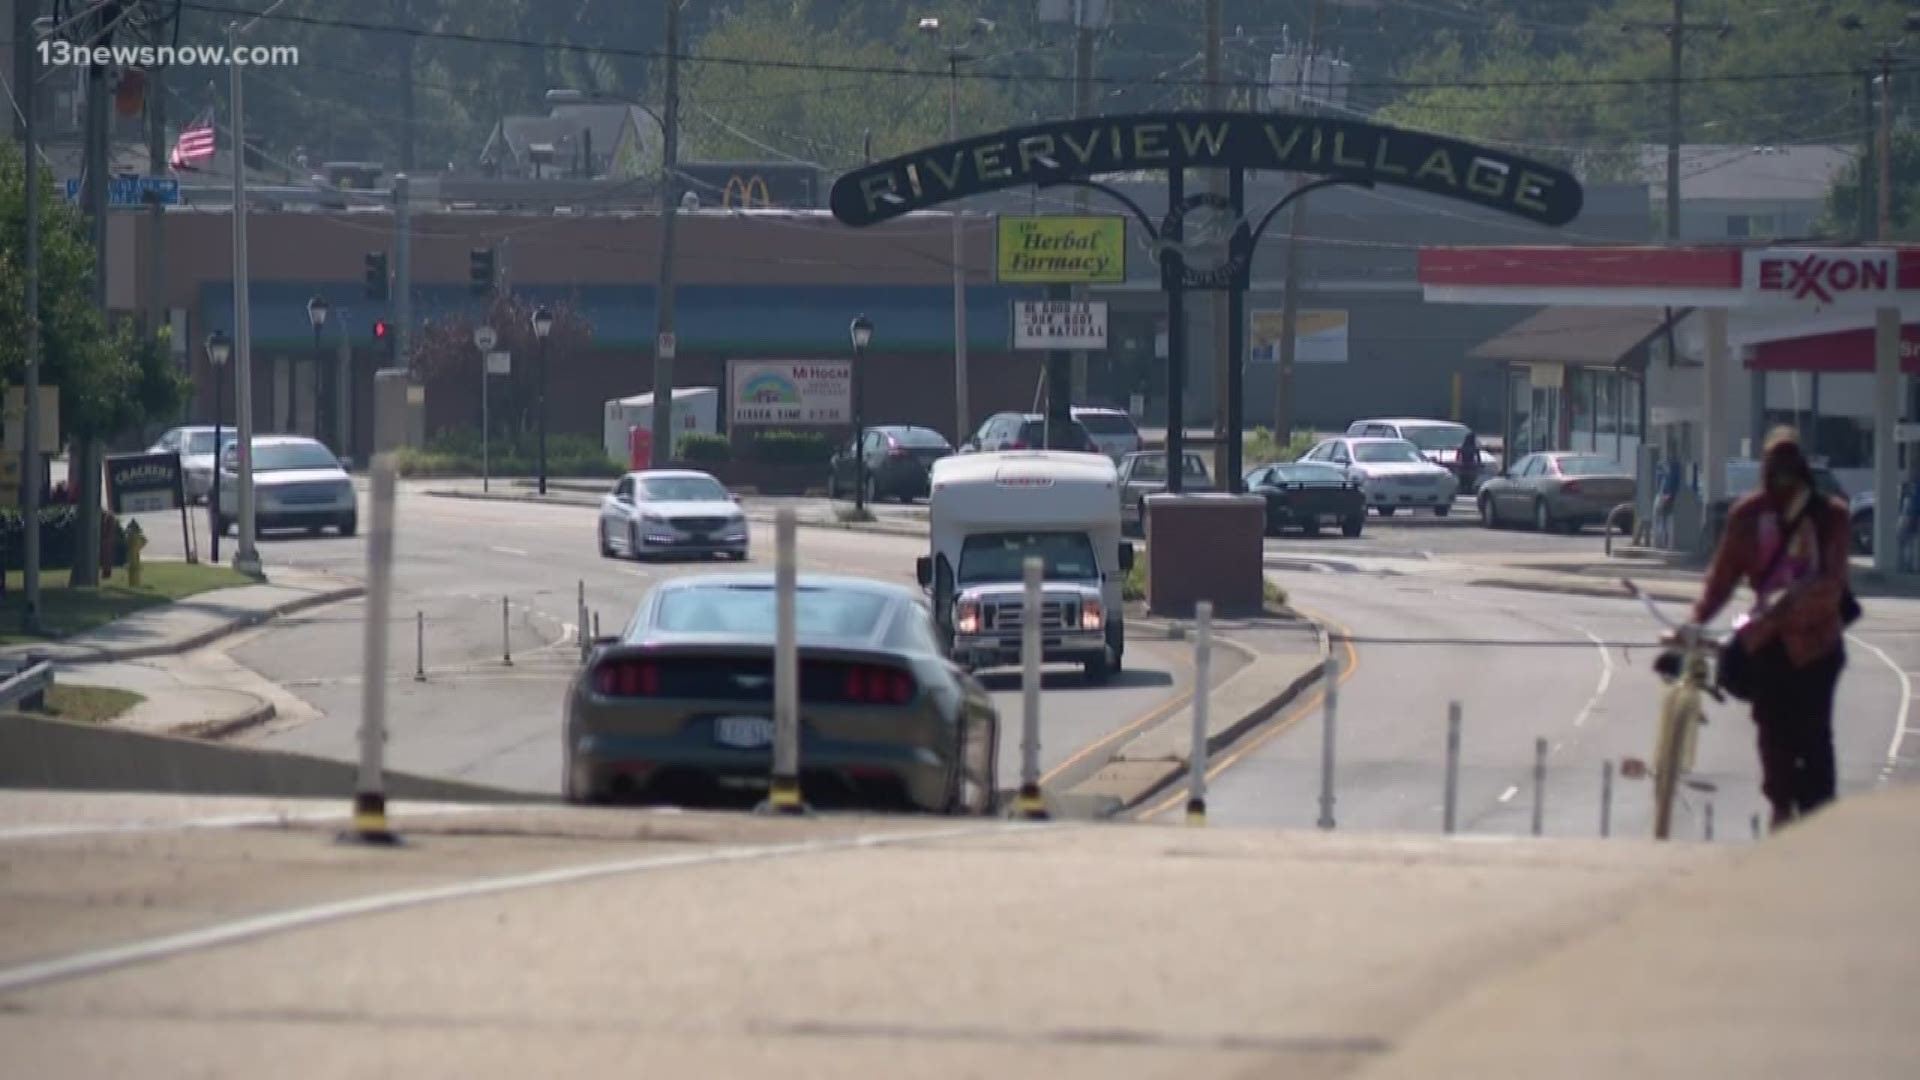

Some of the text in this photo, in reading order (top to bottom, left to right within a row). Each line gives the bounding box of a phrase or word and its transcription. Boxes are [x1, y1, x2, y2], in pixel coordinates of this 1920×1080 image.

[858, 121, 1229, 213] RIVERVIEW
[1263, 124, 1558, 213] VILLAGE
[1023, 230, 1102, 250] Herbal
[1011, 252, 1110, 277] Farmacy
[1760, 252, 1888, 304] EXXON
[1048, 325, 1104, 337] NATURAL
